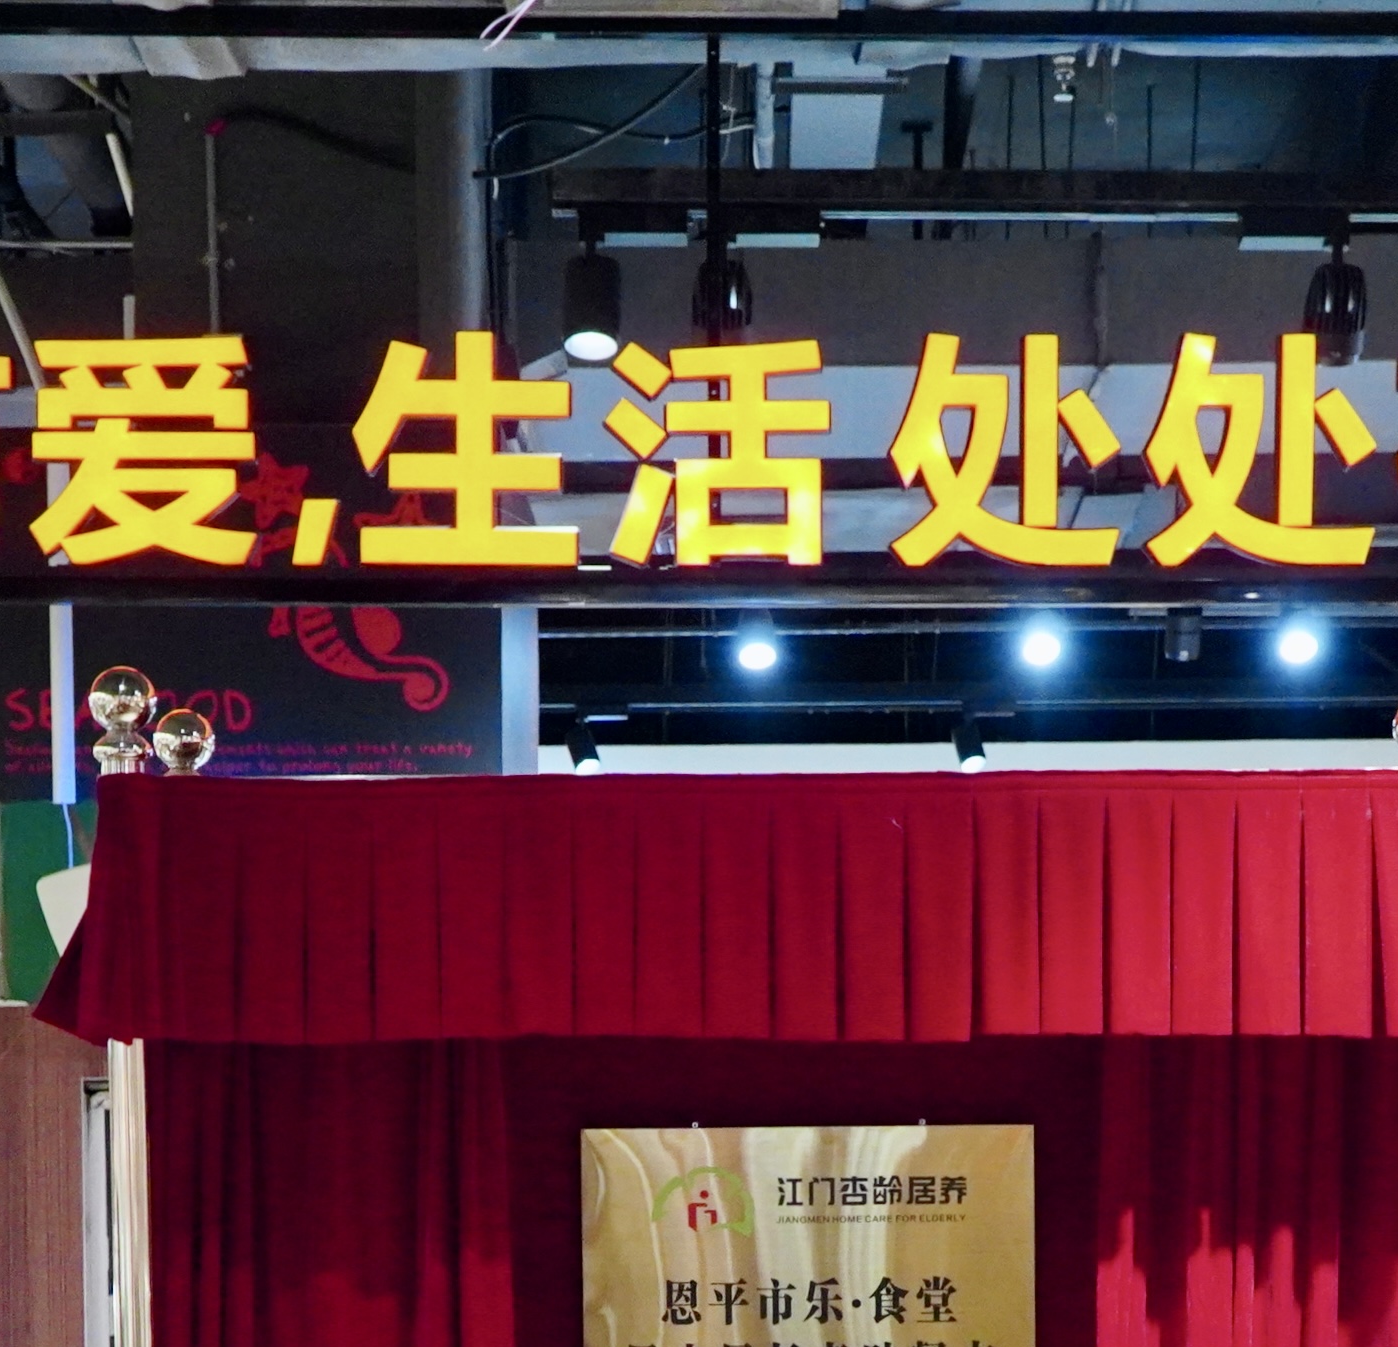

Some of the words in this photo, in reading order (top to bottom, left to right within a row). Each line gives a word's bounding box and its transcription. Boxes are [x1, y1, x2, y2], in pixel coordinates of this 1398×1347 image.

[777, 1175, 967, 1206] 江门杏龄居养
[776, 1216, 830, 1224] JIANGMEN
[865, 1215, 892, 1223] CARE
[896, 1215, 916, 1223] FOR
[919, 1214, 966, 1222] ELDERLY
